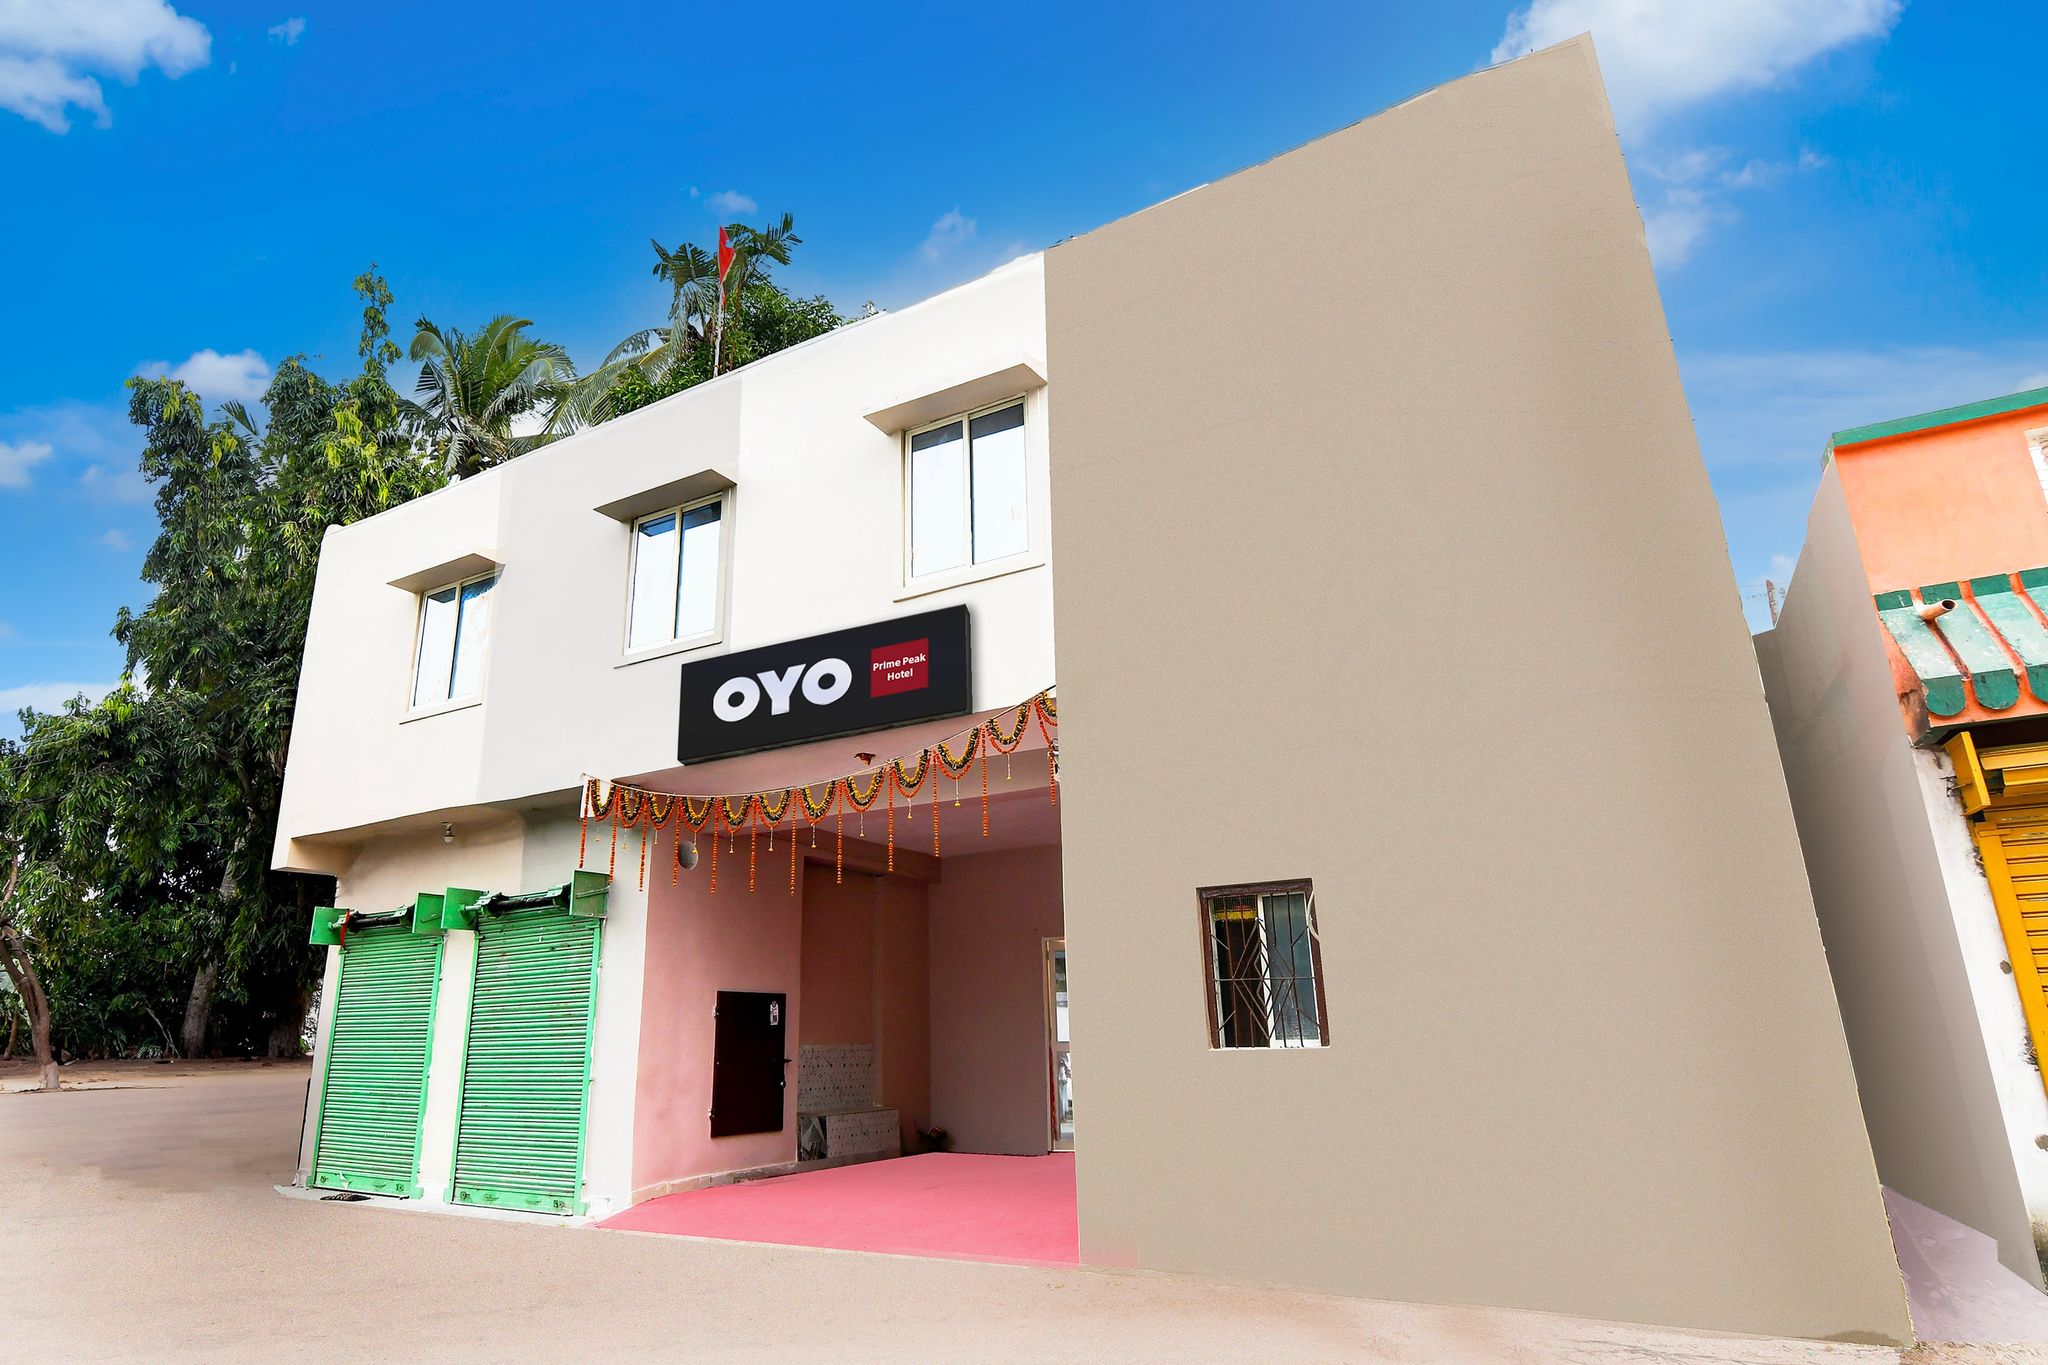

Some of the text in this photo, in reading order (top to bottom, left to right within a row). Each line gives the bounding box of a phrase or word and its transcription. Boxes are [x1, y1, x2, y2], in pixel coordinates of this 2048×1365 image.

[902, 652, 926, 666] Peak
[887, 667, 913, 681] Hotel
[713, 657, 853, 722] OYO
